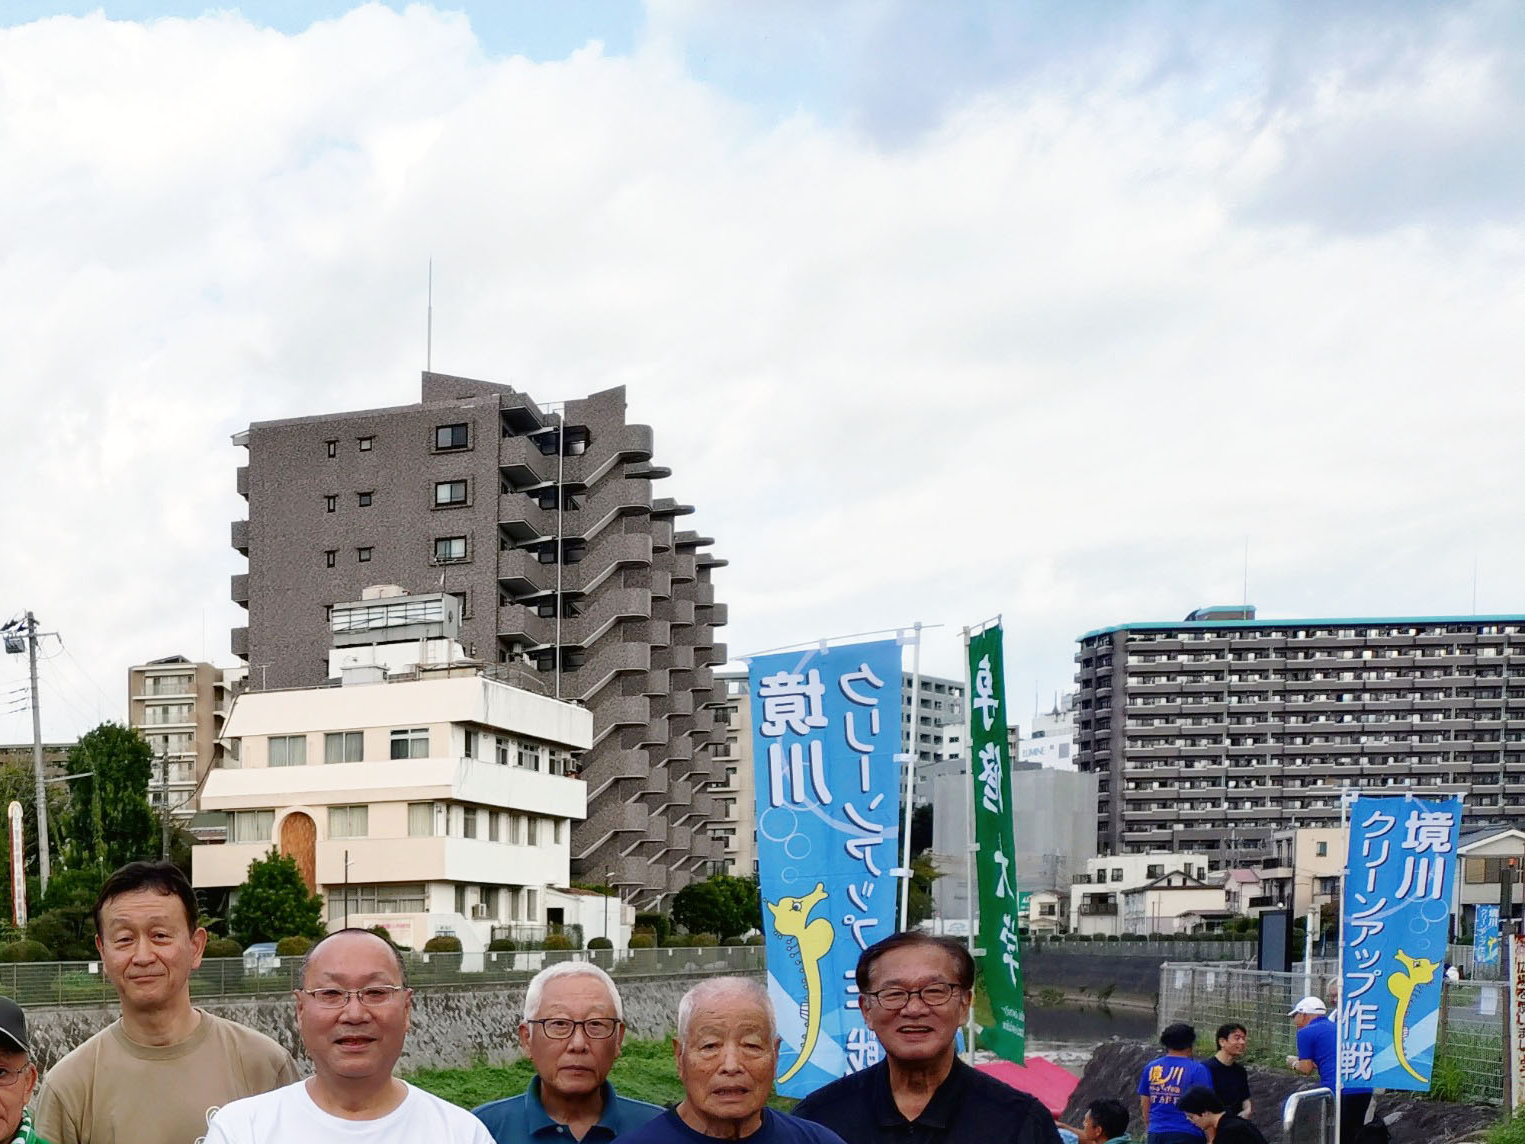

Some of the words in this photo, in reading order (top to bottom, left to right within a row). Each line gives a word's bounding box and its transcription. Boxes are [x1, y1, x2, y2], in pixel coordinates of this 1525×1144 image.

[1341, 810, 1396, 1081] クリーンアップ作戦
[1395, 810, 1454, 901] 境川
